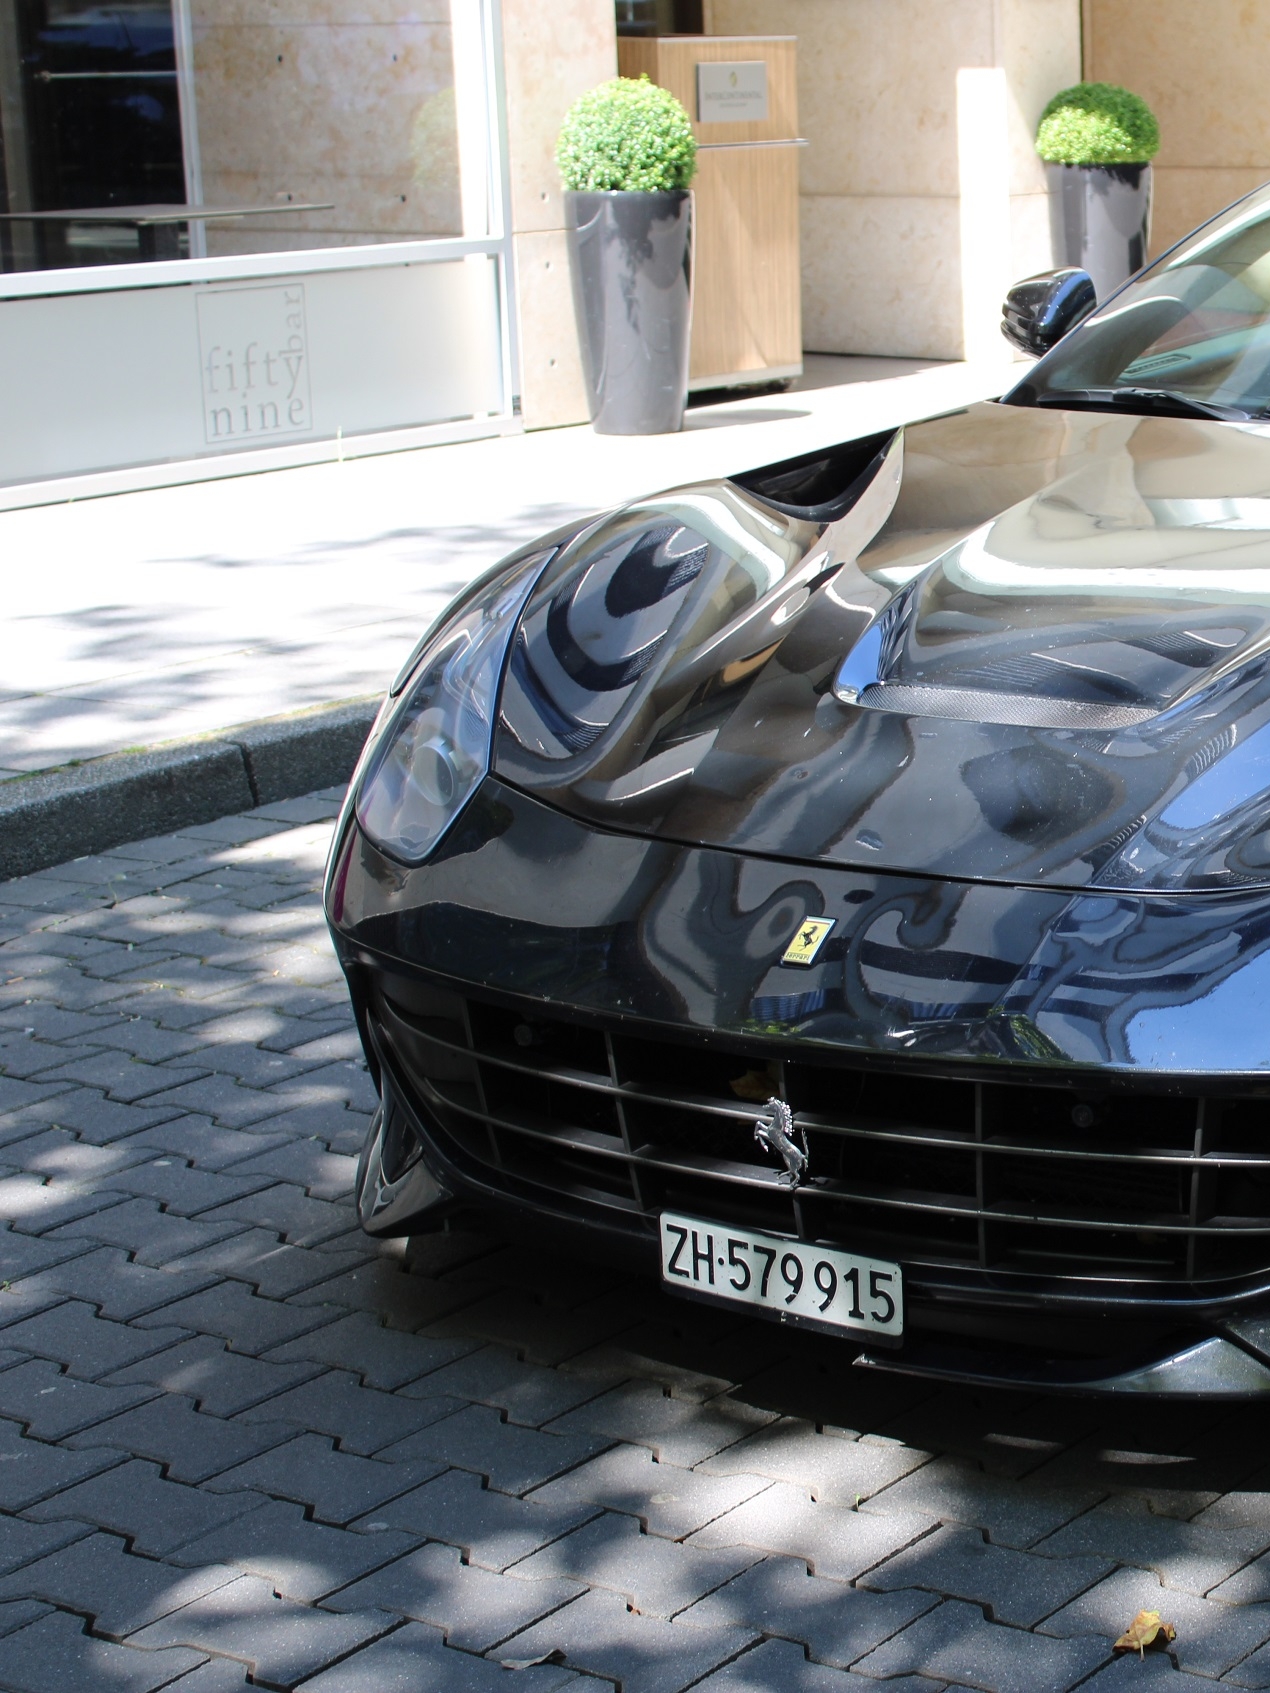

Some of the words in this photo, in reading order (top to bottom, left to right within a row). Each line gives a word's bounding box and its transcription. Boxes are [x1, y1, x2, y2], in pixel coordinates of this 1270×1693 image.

[279, 291, 304, 356] bar
[205, 341, 303, 399] fifty
[210, 391, 304, 436] nine
